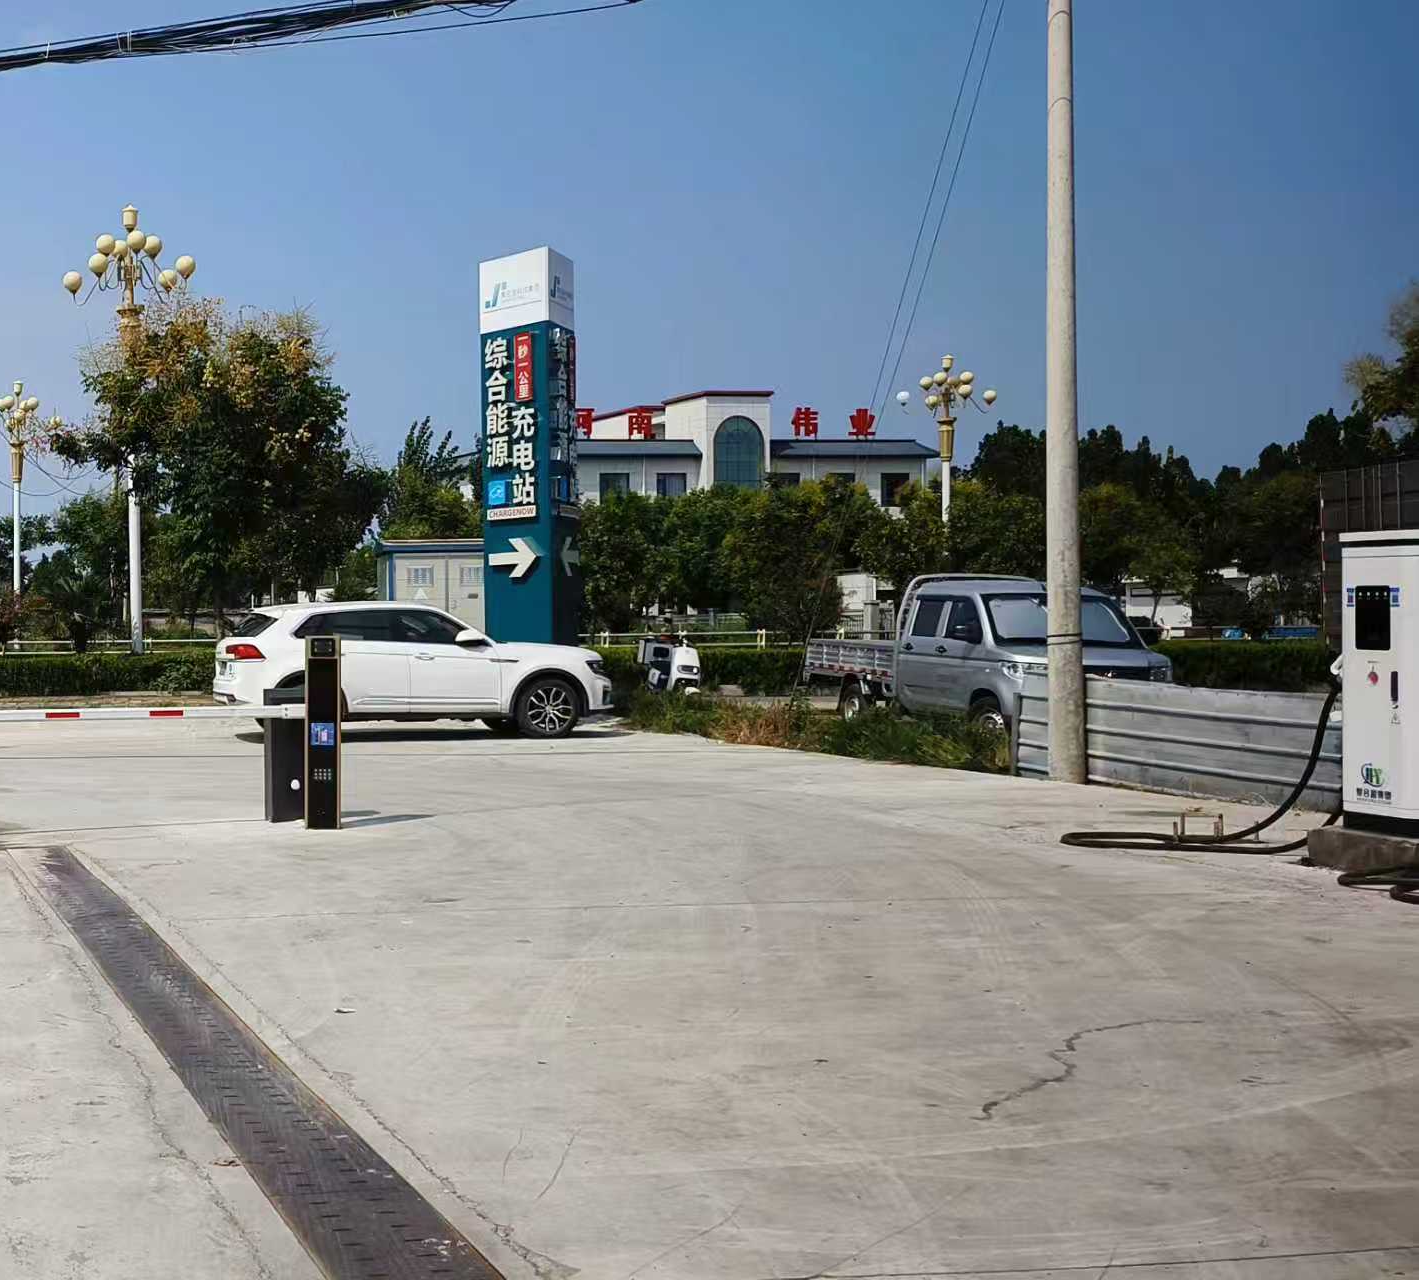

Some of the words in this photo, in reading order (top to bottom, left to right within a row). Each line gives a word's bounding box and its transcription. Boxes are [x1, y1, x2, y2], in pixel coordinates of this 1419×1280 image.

[485, 337, 509, 468] 综合能源
[517, 335, 530, 400] 一秒一公里
[511, 405, 535, 504] 充电站
[488, 507, 535, 519] CHARGENOW
